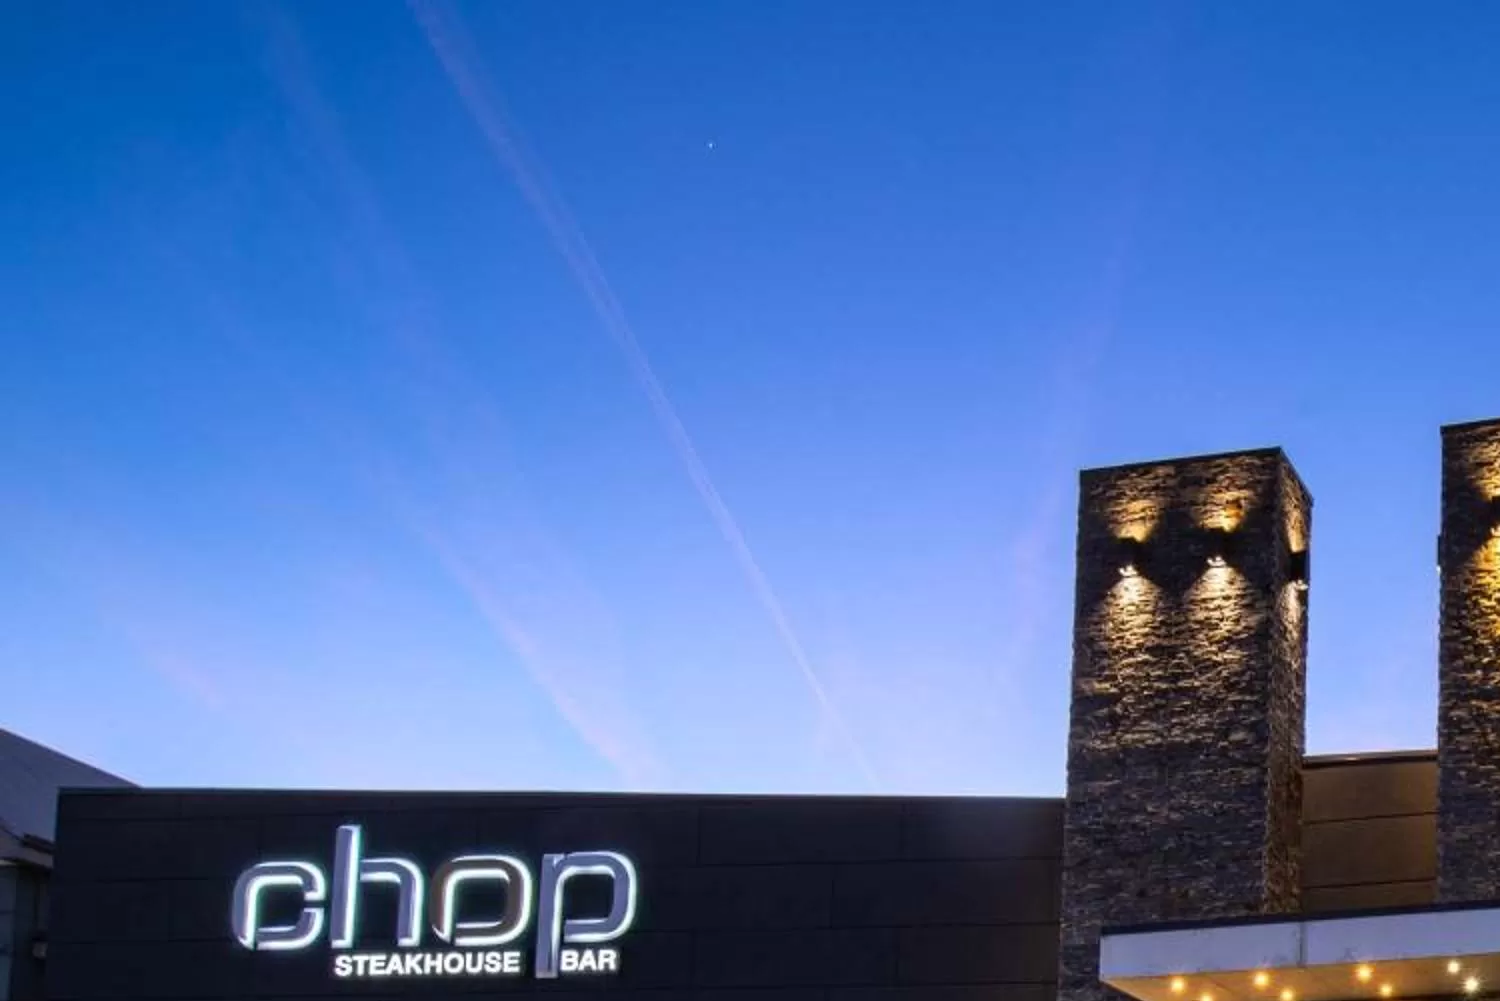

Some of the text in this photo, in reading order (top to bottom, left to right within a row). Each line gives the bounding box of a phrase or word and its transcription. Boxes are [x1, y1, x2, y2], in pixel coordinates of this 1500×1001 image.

[231, 823, 638, 979] chop
[333, 948, 618, 977] STEAKHOUSE BAR
